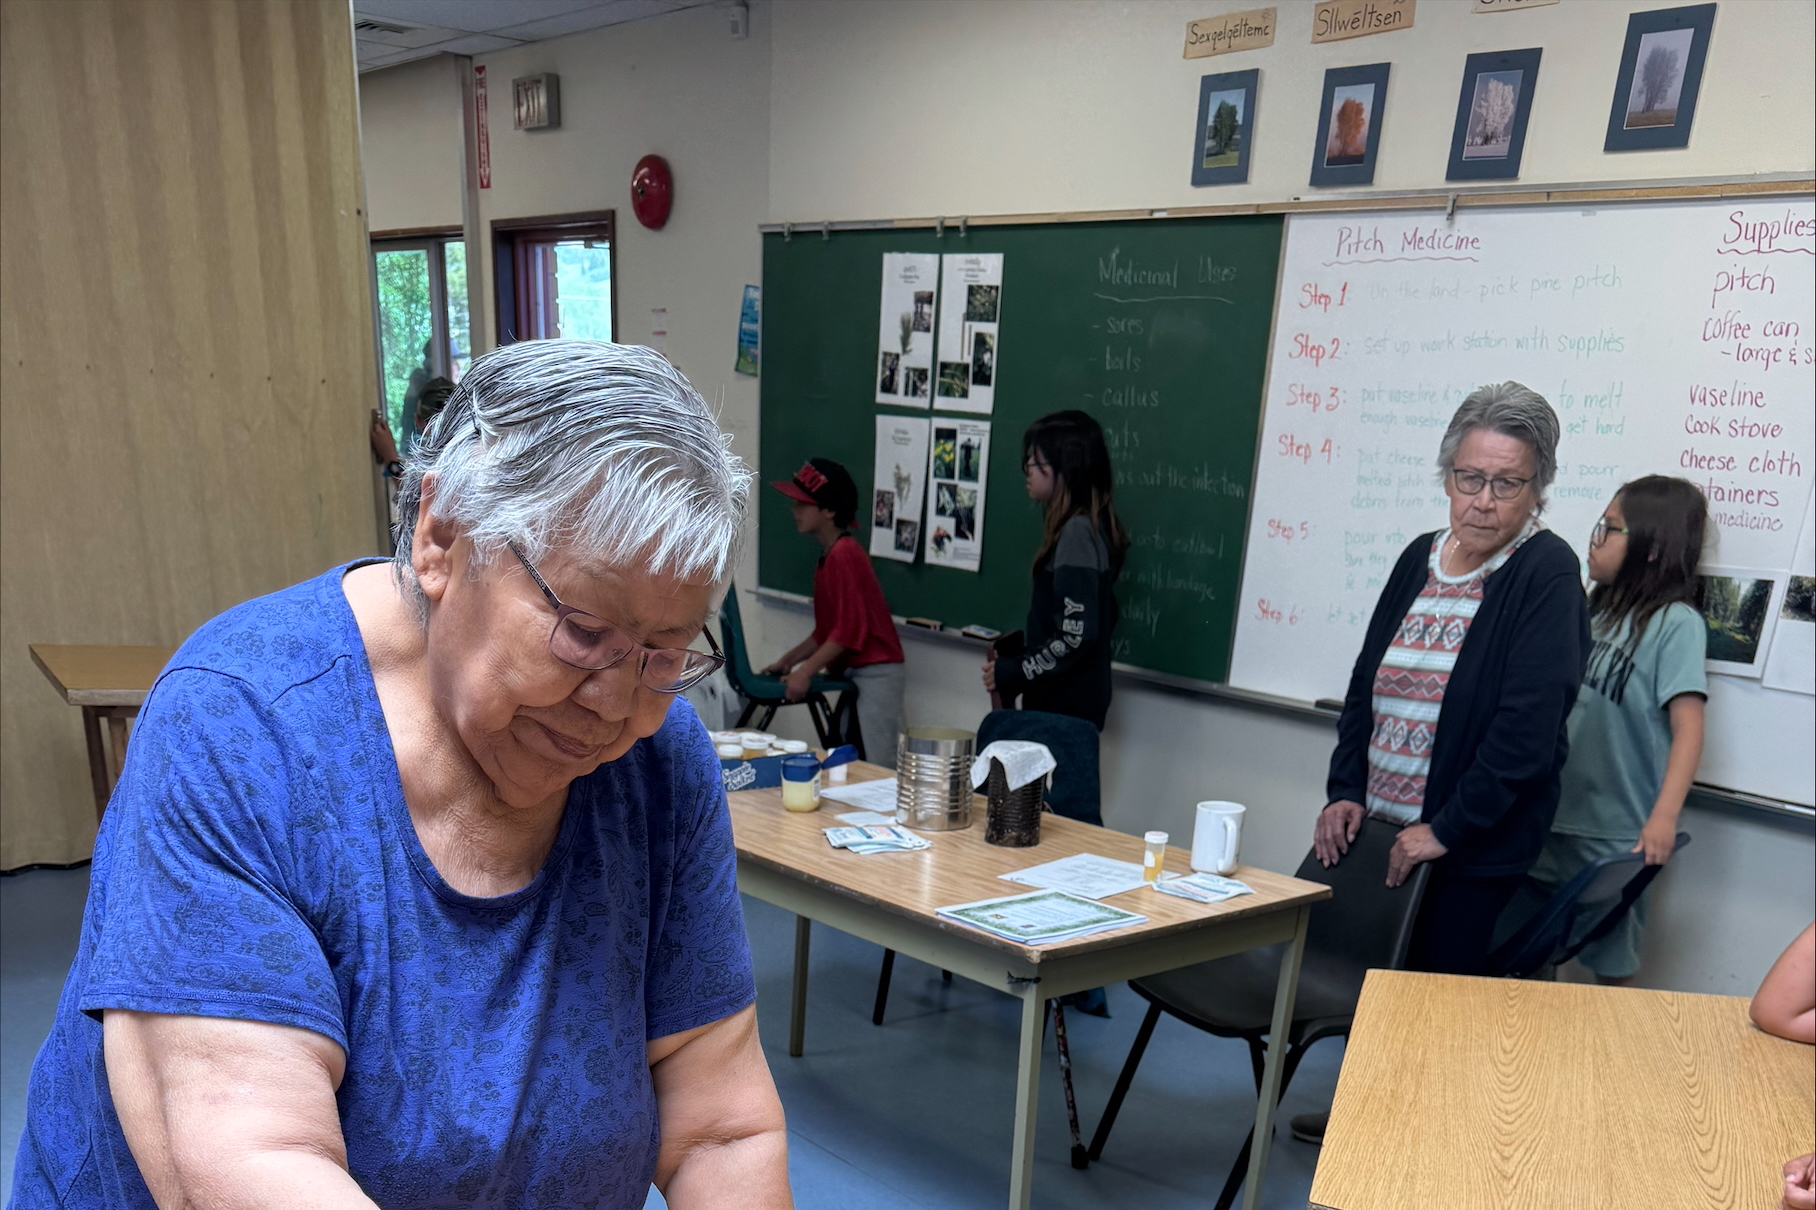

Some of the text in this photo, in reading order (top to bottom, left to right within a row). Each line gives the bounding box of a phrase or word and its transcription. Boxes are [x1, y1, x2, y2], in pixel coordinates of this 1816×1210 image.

[1336, 226, 1481, 257] Pitch Medicine
[1723, 209, 1815, 253] Supplies
[1099, 255, 1237, 289] Medicinal Uses
[1712, 264, 1775, 309] pitch
[1299, 283, 1332, 312] Step
[1479, 275, 1519, 302] pick
[1572, 264, 1622, 298] pitch
[1106, 316, 1144, 334] sores
[1763, 320, 1799, 338] can
[1289, 333, 1325, 367] Step
[1515, 325, 1549, 351] with
[1557, 327, 1625, 358] supplies
[1286, 383, 1321, 413] Step
[1584, 381, 1623, 408] melt
[1278, 433, 1312, 465] Step
[1748, 450, 1801, 477] cloth
[1267, 518, 1295, 544] Step
[1714, 509, 1784, 532] medicine
[1255, 598, 1283, 624] Step
